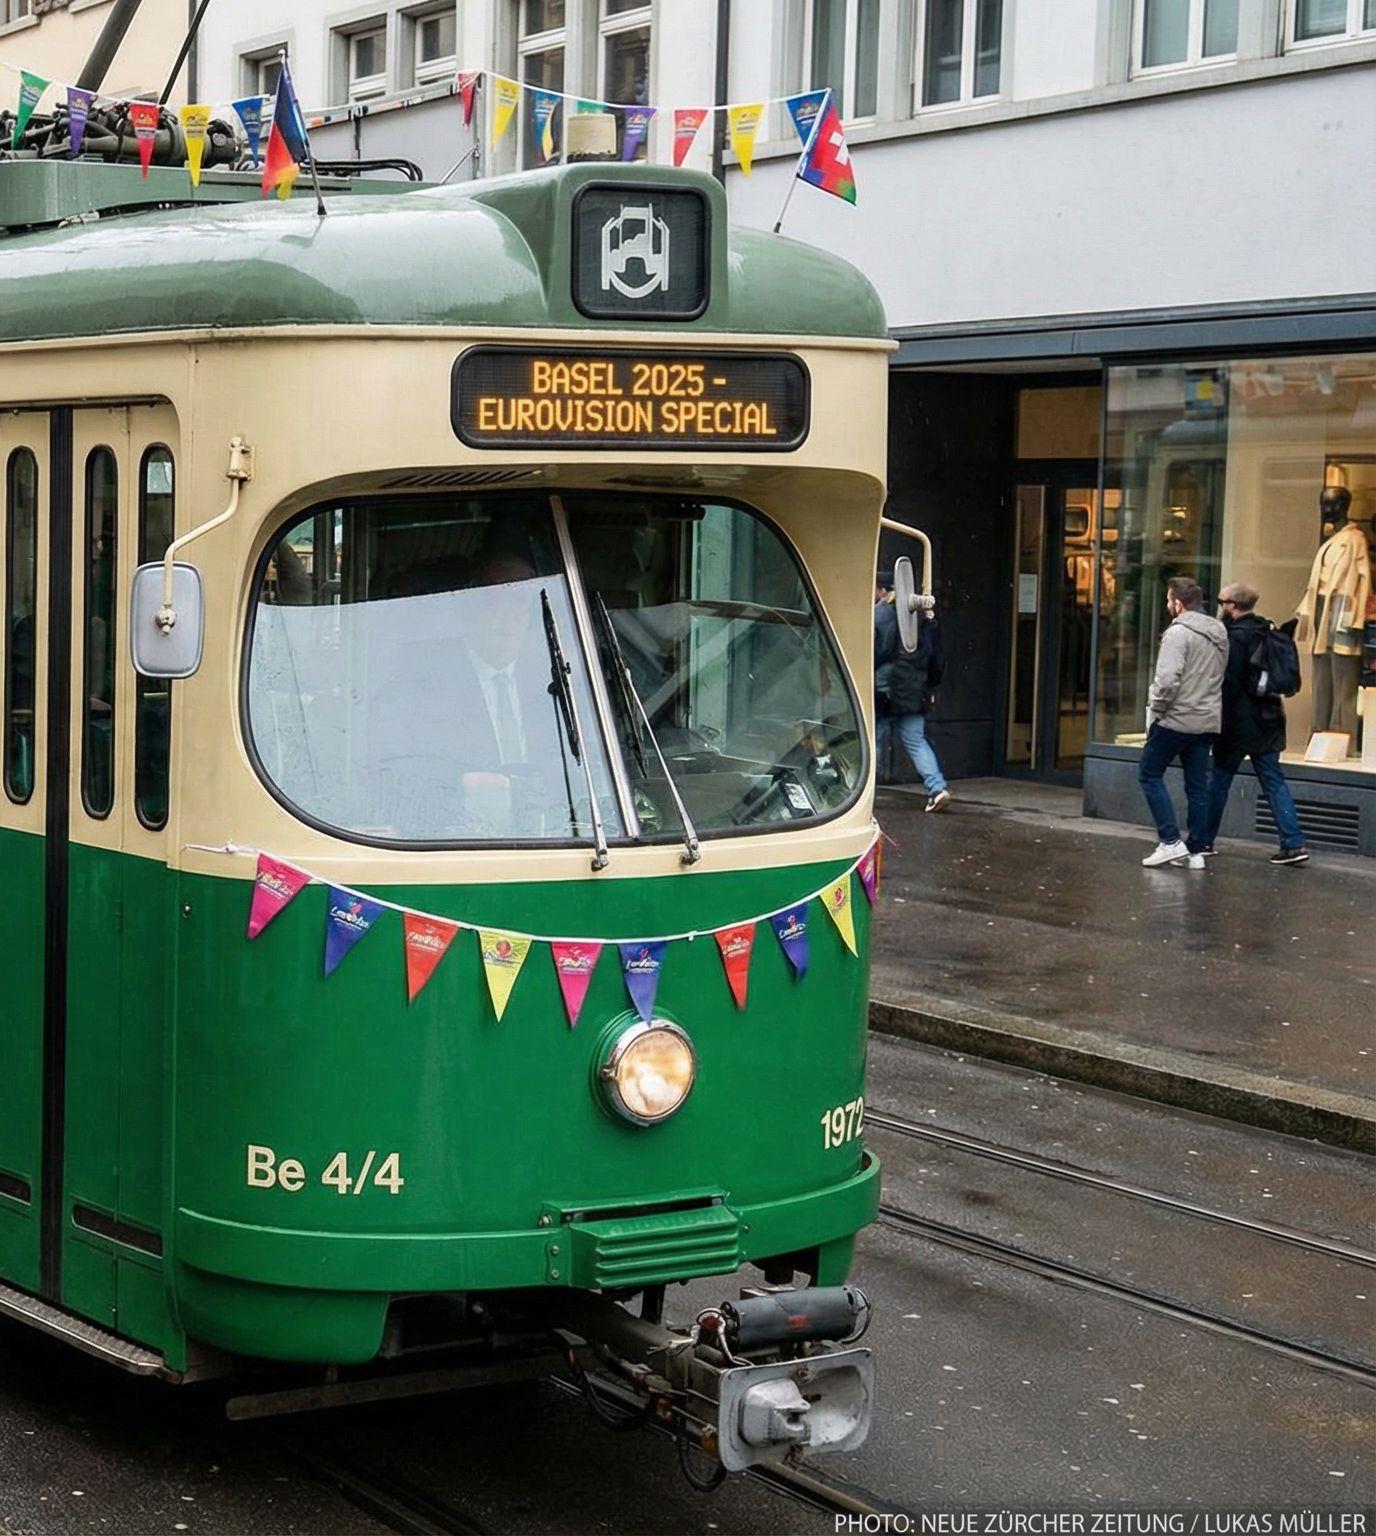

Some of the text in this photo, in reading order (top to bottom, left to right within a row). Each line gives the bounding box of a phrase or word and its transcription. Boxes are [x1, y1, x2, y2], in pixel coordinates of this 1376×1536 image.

[533, 361, 623, 395] BASEL
[632, 364, 705, 396] 2025
[479, 398, 777, 435] EUROVISION SPECIAL
[820, 1096, 864, 1150] 1972
[247, 1144, 405, 1195] Be 4/4
